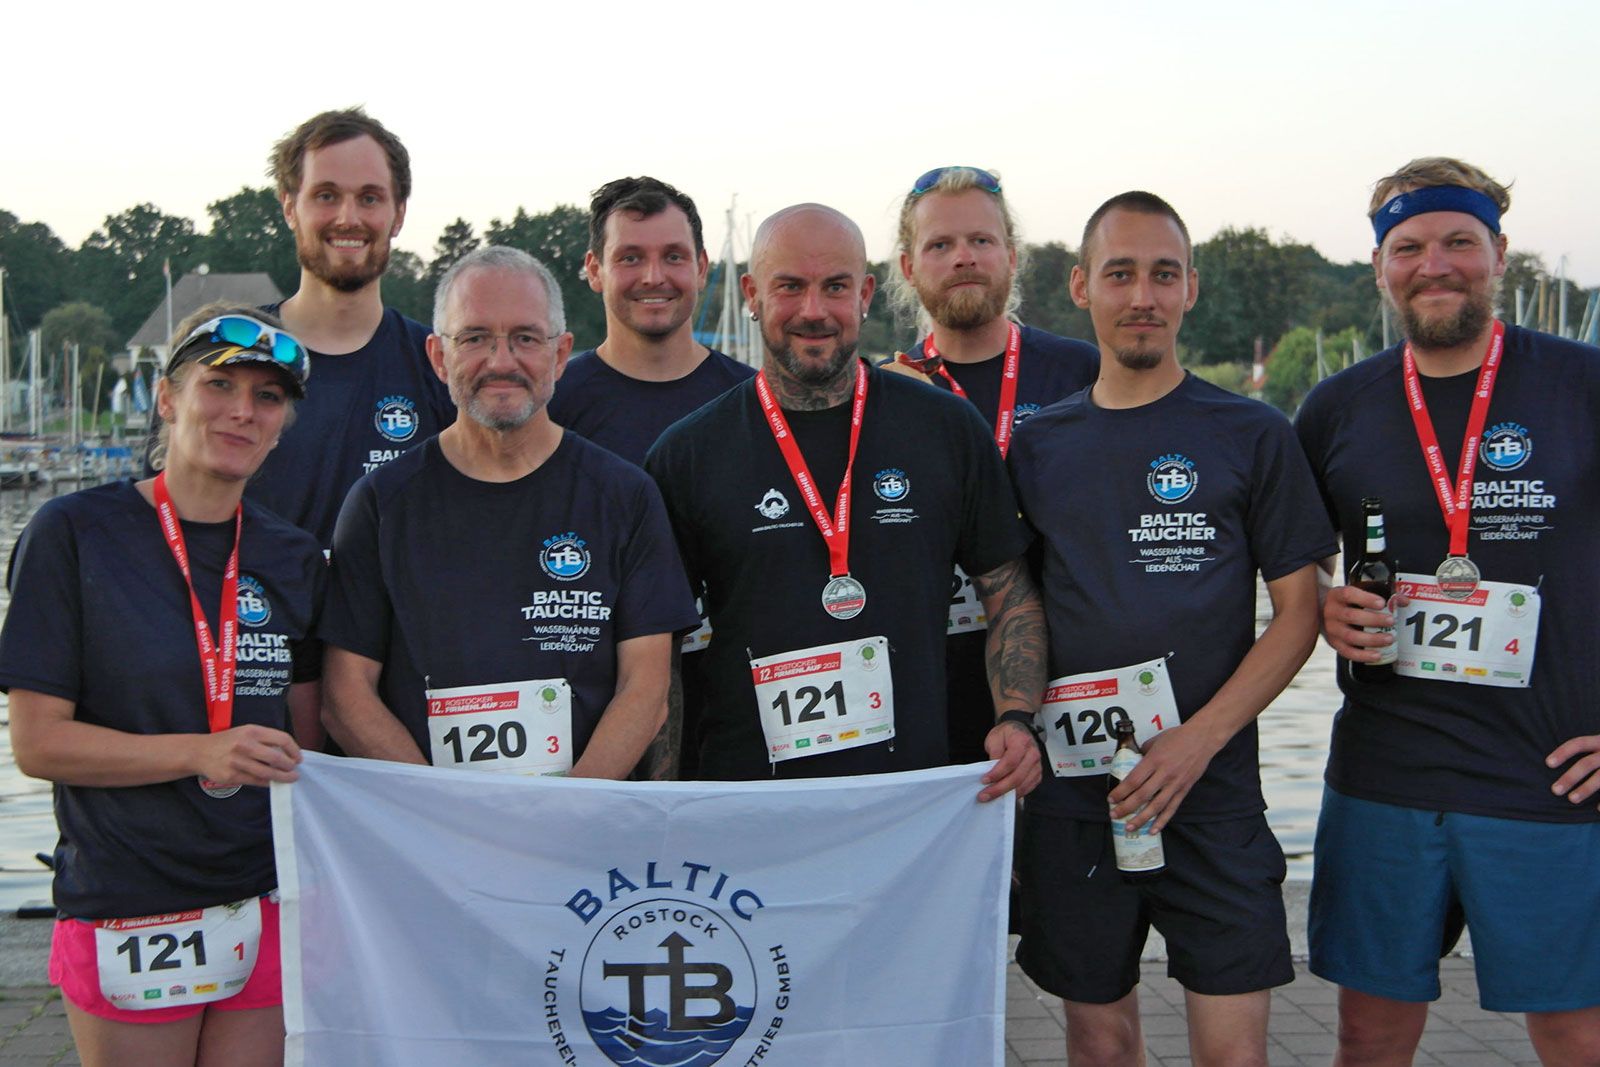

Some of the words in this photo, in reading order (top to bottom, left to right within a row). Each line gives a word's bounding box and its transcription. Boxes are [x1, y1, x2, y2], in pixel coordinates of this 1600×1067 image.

[1150, 454, 1195, 469] BALTIC
[1473, 480, 1545, 495] BALTIC
[1470, 494, 1556, 508] AUCHER
[1140, 513, 1207, 528] BALTIC
[1128, 527, 1216, 542] TAUCHER
[1140, 546, 1205, 556] WASSERMÄNNER
[1165, 556, 1182, 564] AUS
[1145, 563, 1200, 573] LEIDENSCHAFT
[533, 590, 602, 605] BALTIC
[1400, 585, 1414, 597] 12.
[521, 605, 611, 620] TAUCHER
[534, 625, 600, 635] WASSERMÄNNER
[1405, 610, 1483, 652] 121
[561, 634, 577, 643] AUS
[540, 642, 595, 652] LEIDENSCHAFT
[1504, 639, 1520, 655] 4
[759, 669, 773, 682] 12.
[772, 680, 847, 726] 121
[868, 691, 882, 709] 3
[431, 702, 444, 714] 12.
[444, 702, 497, 713] FIRMENLAUF
[1055, 706, 1131, 746] 120
[1151, 714, 1163, 731] 1
[443, 721, 527, 763] 120
[546, 736, 559, 754] 3
[564, 861, 765, 926] BALTIC
[613, 908, 719, 941] ROSTOCK
[117, 930, 206, 974] 121
[234, 942, 244, 961] 1
[543, 948, 577, 1067] TAUCHEREI-
[744, 1016, 784, 1067] TRIEB
[769, 944, 791, 1011] GMBH
